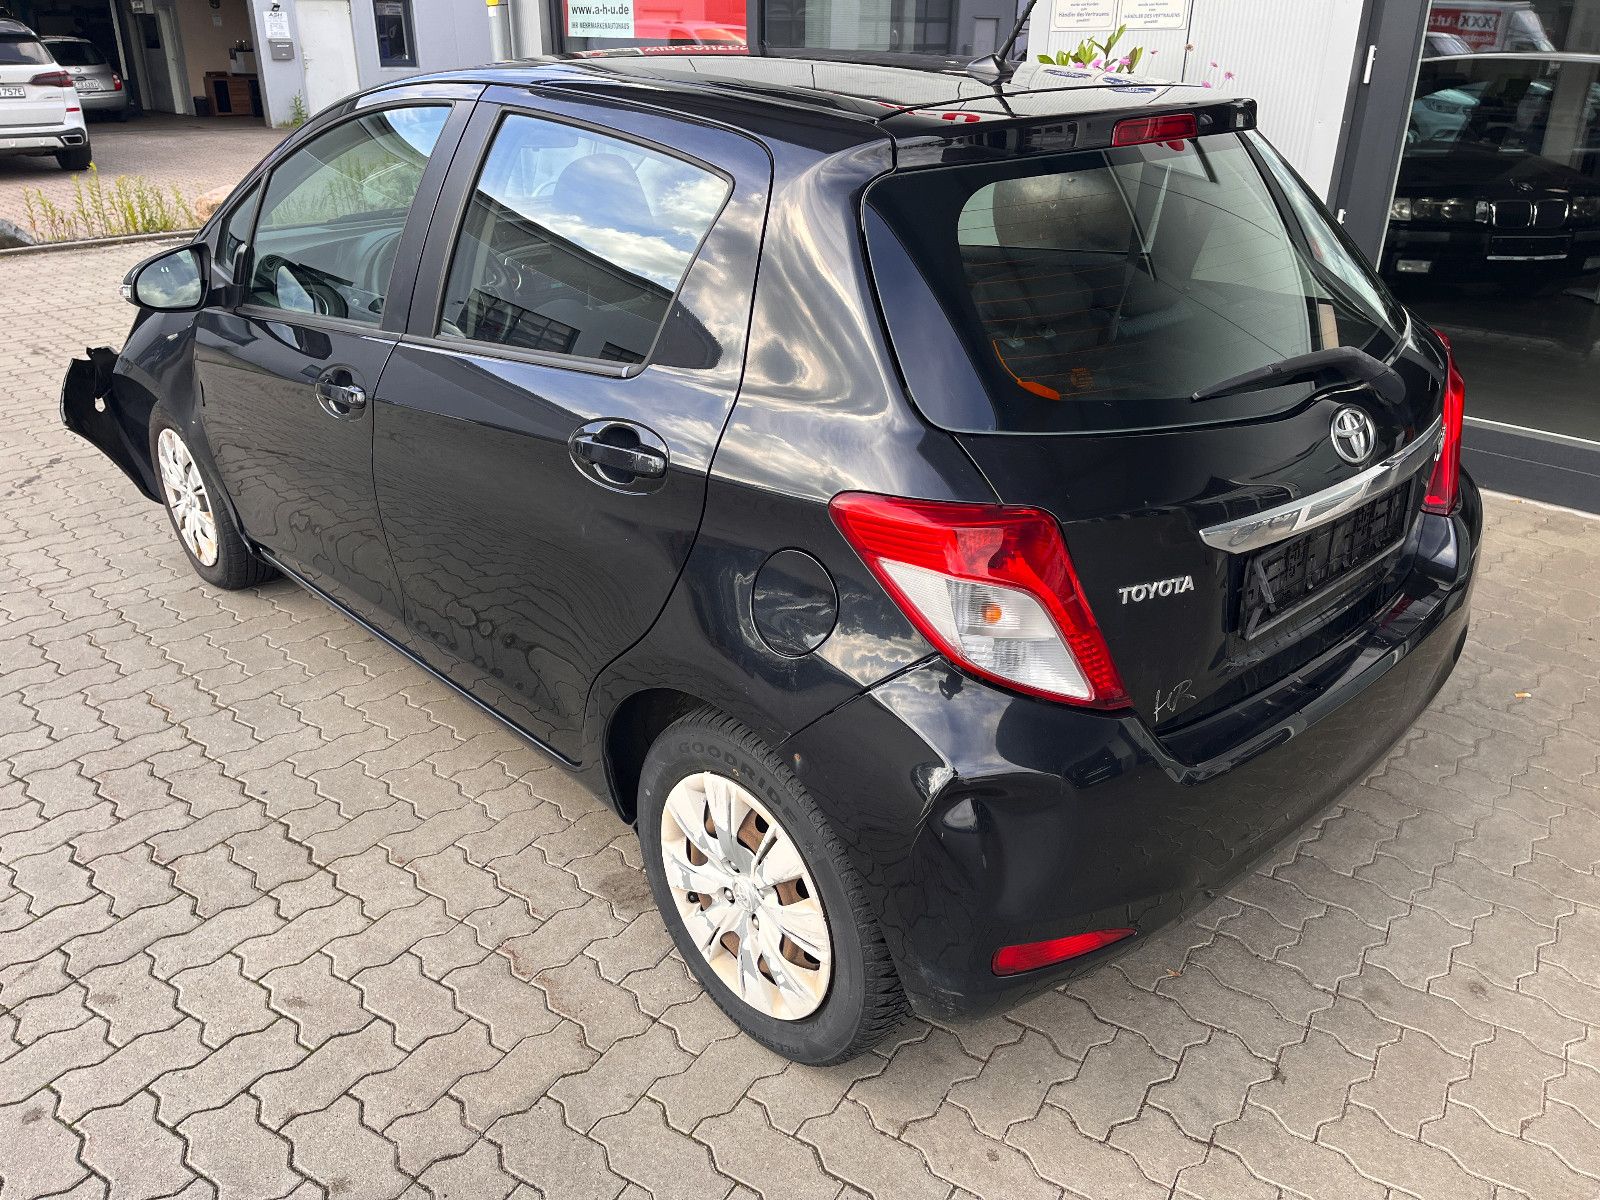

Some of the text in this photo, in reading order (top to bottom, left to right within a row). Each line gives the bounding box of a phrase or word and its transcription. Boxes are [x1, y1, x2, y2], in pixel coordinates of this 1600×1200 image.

[571, 4, 630, 15] www.a-h-u.de
[1118, 576, 1195, 605] TOYOTA
[678, 741, 800, 827] GOODRIDE
